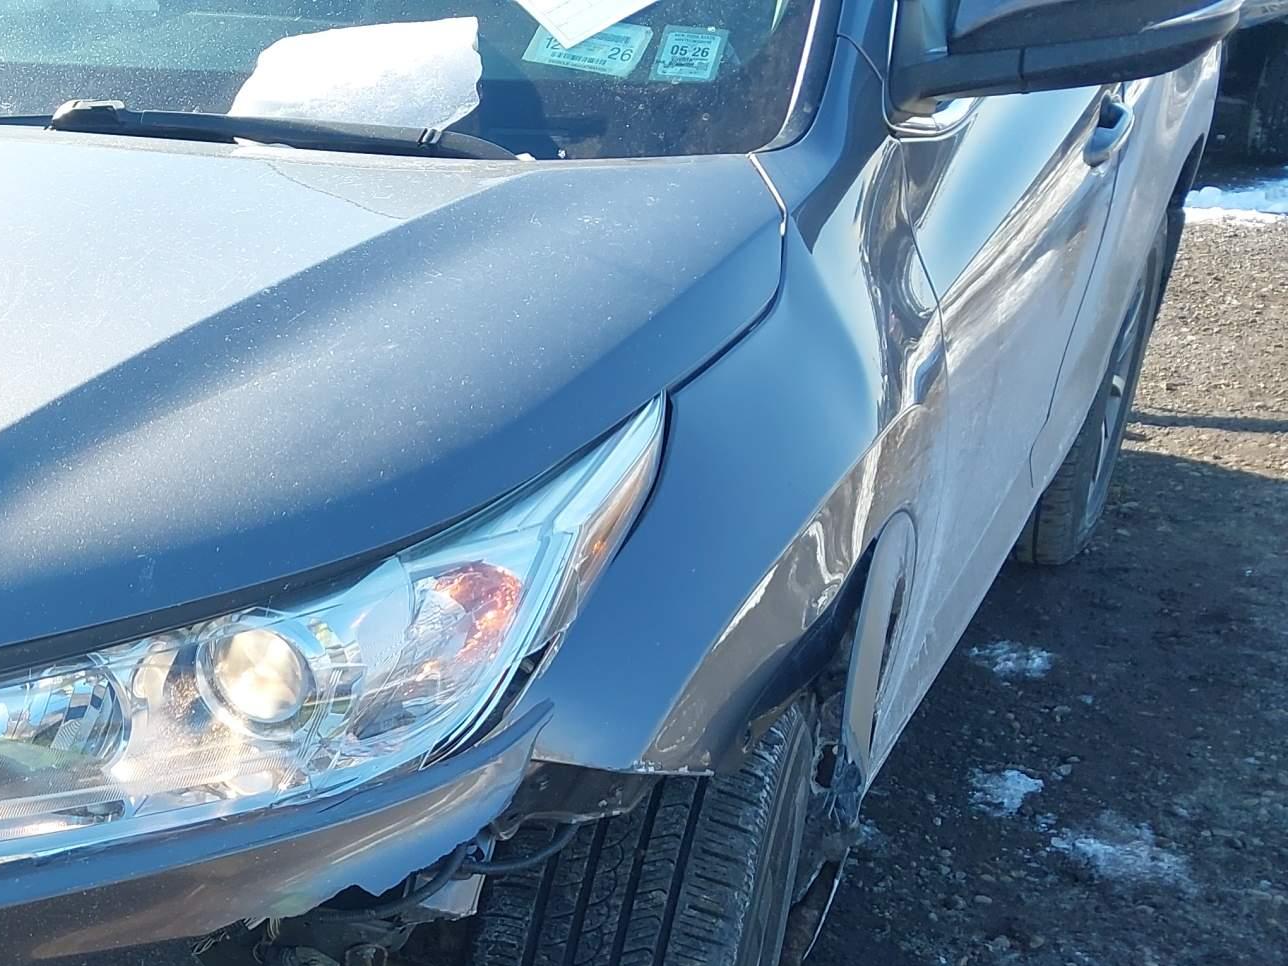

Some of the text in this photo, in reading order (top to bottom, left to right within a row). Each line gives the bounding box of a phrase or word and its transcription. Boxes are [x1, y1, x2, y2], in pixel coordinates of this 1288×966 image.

[608, 47, 633, 62] 26
[670, 45, 710, 58] 05 26
